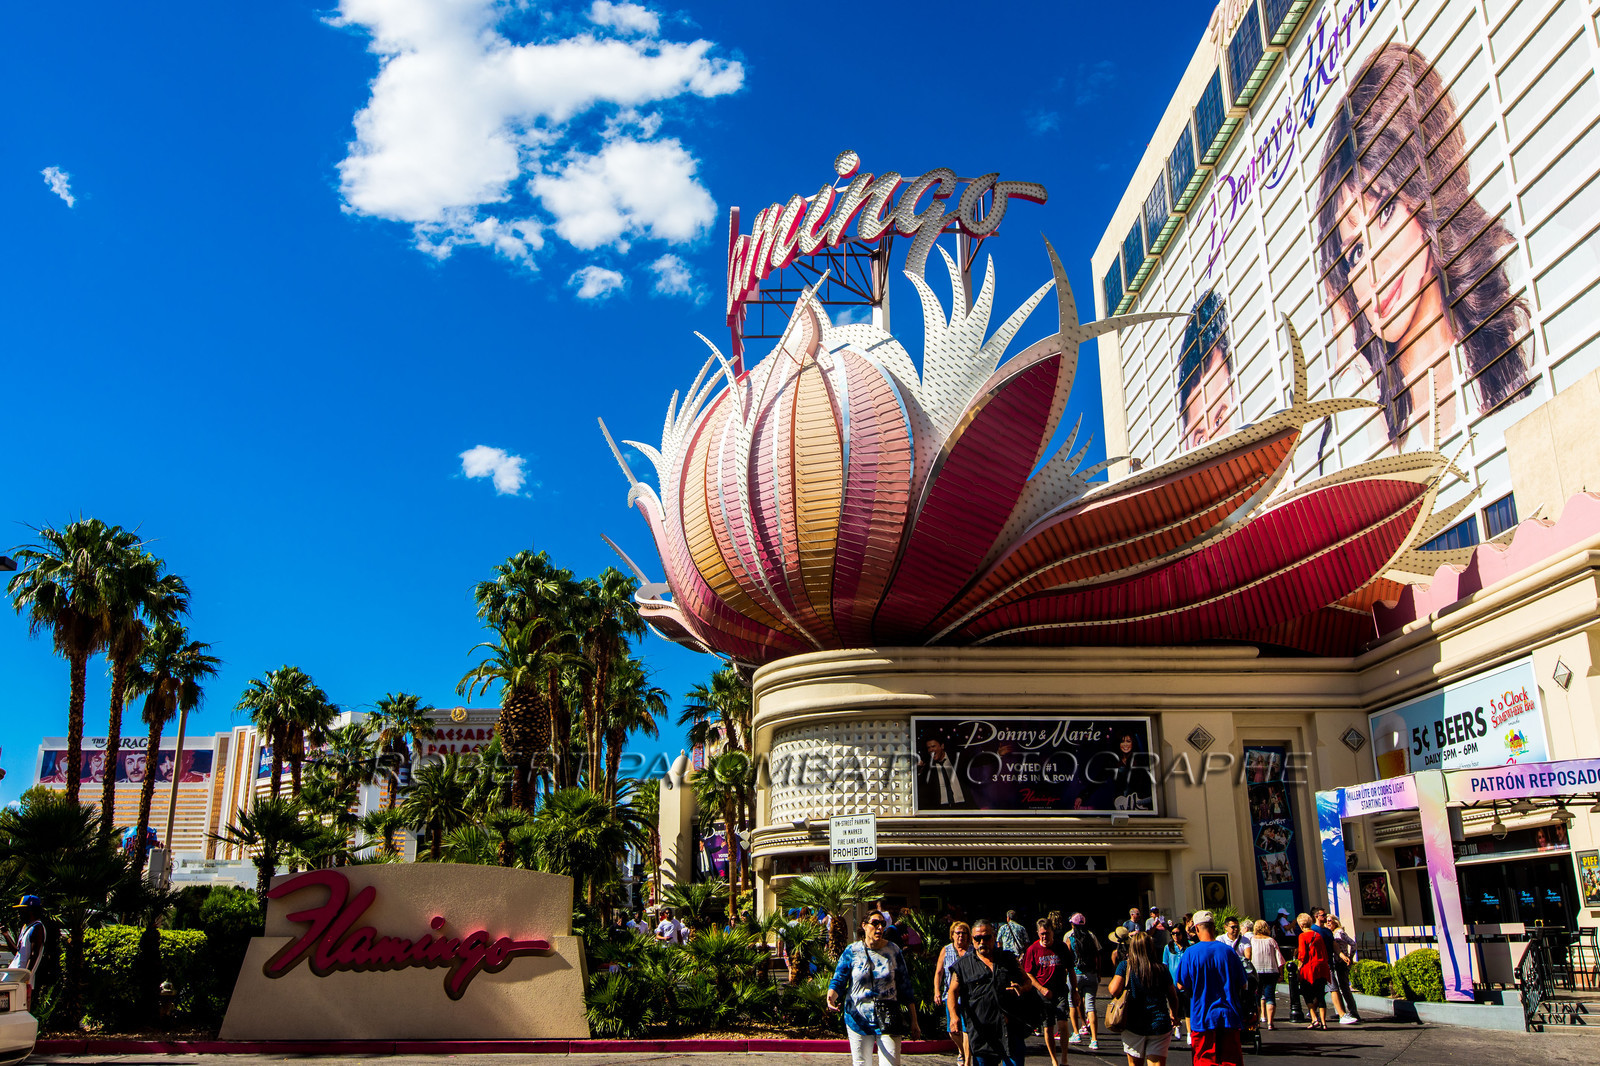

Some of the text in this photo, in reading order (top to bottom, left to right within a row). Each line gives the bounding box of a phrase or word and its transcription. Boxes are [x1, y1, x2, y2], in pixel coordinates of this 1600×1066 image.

[1490, 699, 1497, 714] 5
[957, 720, 1101, 750] Donny & Marie
[1412, 725, 1430, 756] 5¢
[1434, 706, 1488, 749] BEERS
[1424, 752, 1441, 766] DAILY
[1443, 748, 1457, 760] 5PM
[1463, 742, 1478, 755] 6PM
[1006, 763, 1057, 772] VOTED #1
[1471, 772, 1526, 793] PATRÓN
[1346, 781, 1405, 801] MILLER LITE OR COORS LIGHT
[1361, 798, 1381, 810] STARTING
[1382, 797, 1387, 807] AT
[834, 819, 853, 827] ON-STREET
[833, 846, 874, 858] PROHIBITED
[884, 857, 1054, 871] THE LINQ HIGH ROLLER
[1582, 856, 1598, 866] PIFF
[266, 868, 552, 1000] Flamingo
